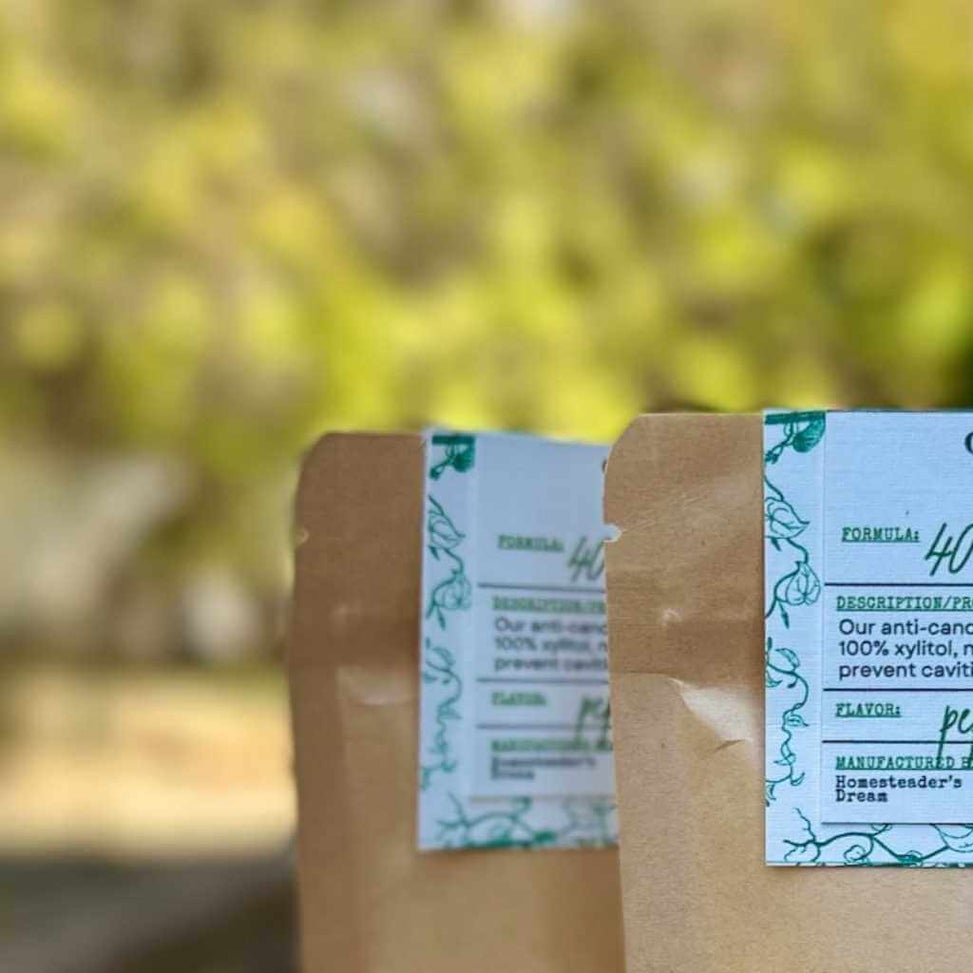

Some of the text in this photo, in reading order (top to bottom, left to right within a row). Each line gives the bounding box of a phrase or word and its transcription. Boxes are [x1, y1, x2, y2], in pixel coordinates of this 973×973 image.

[841, 526, 920, 543] FORMULA:
[838, 618, 876, 636] Our
[838, 640, 889, 656] 100%
[894, 640, 958, 659] xylitol,
[838, 663, 917, 681] prevent
[835, 703, 902, 718] FLAVOR:
[835, 756, 955, 771] MANUFACTURED
[835, 775, 963, 789] Homesteader's
[835, 788, 889, 802] Dream
